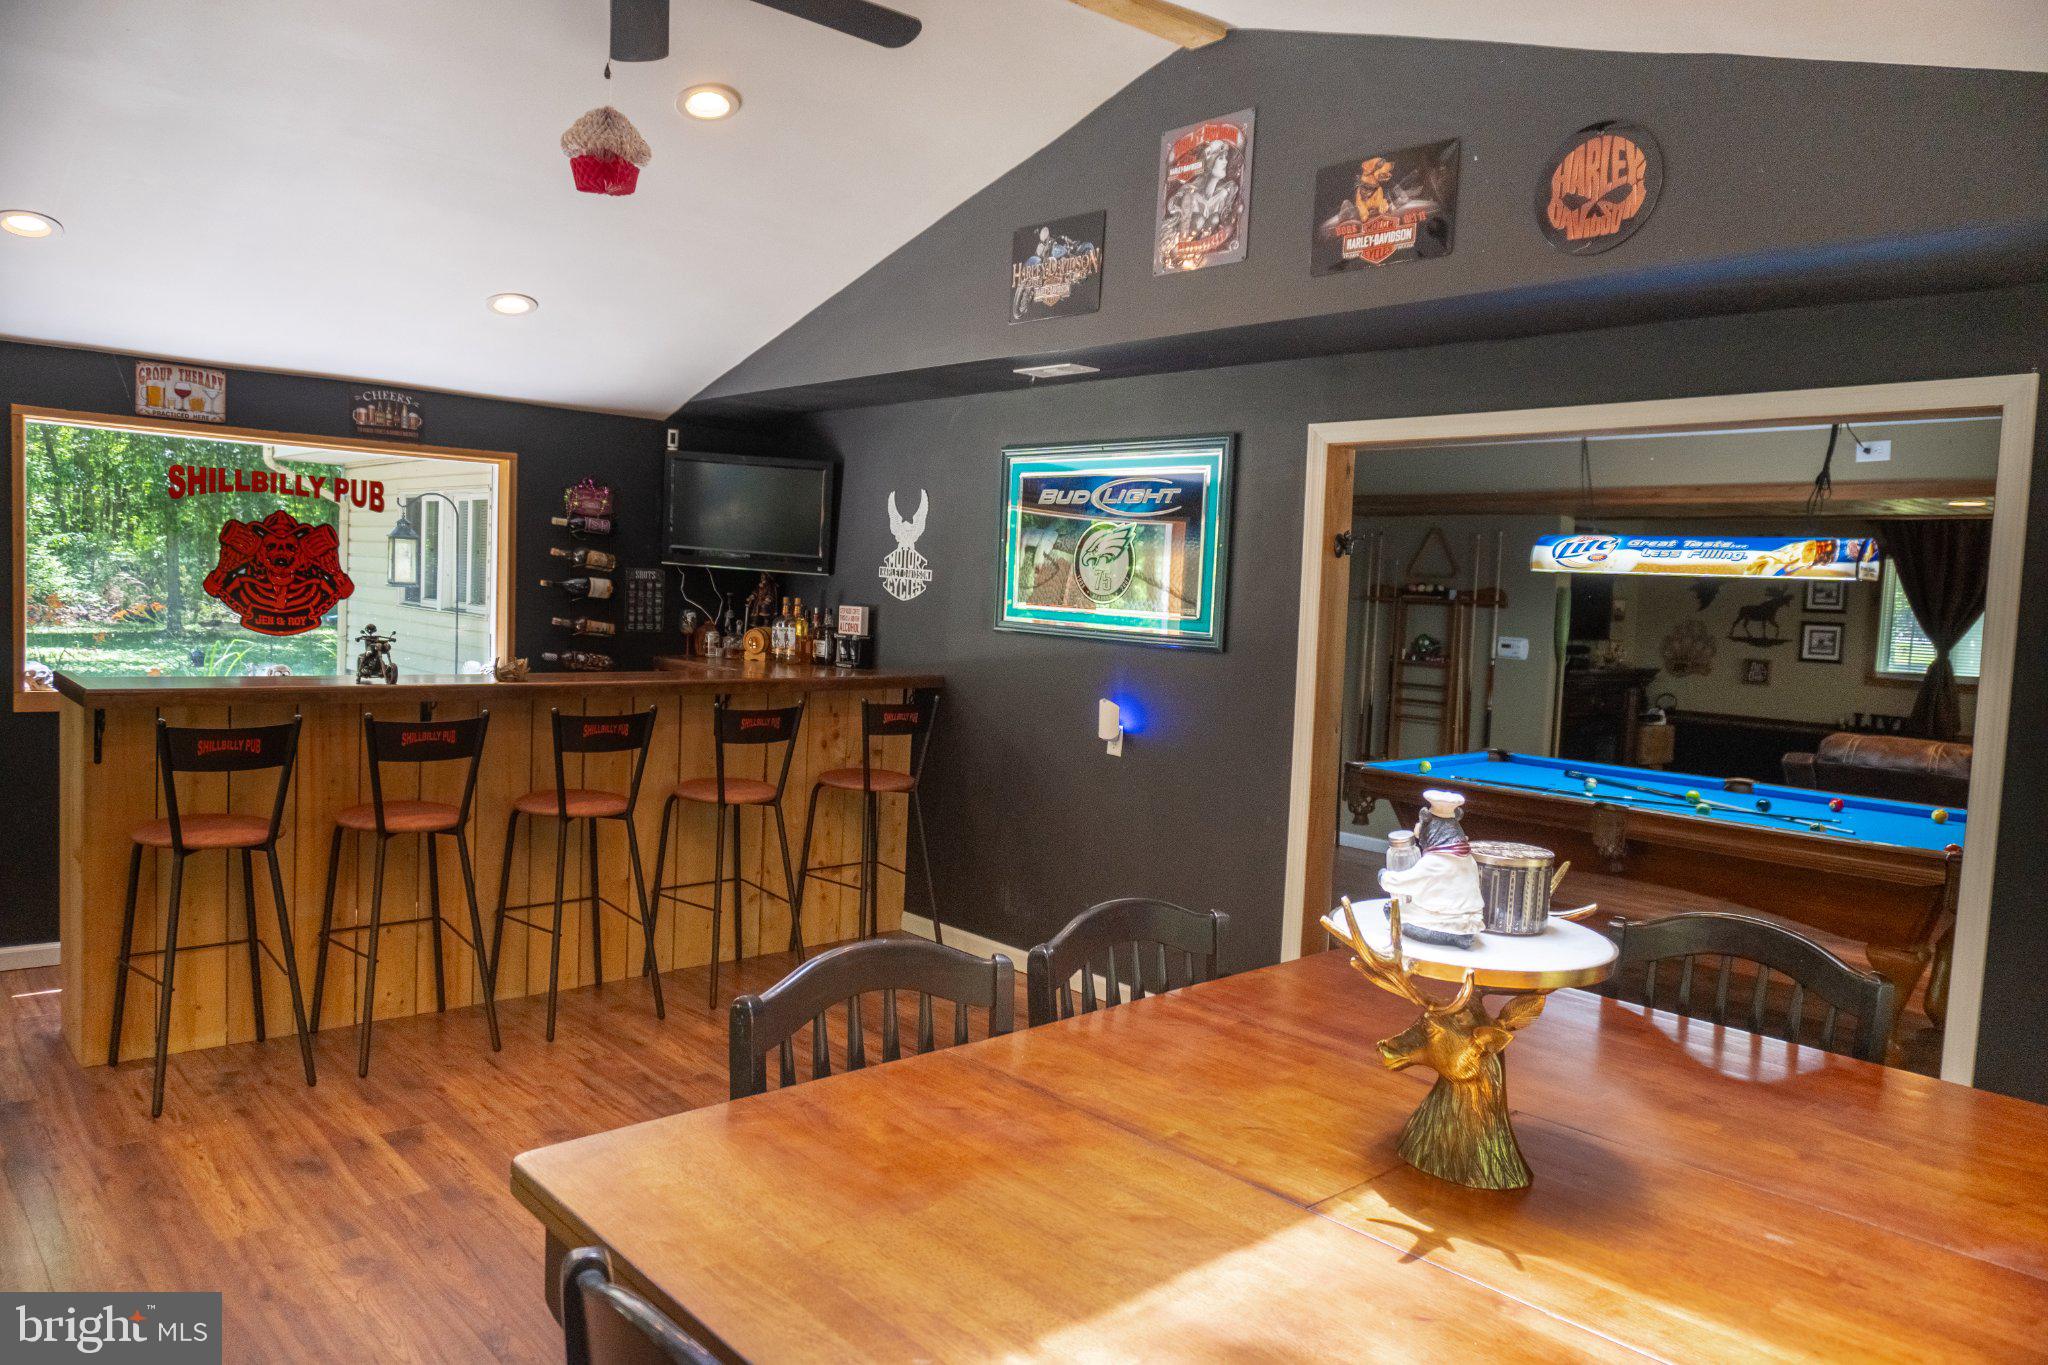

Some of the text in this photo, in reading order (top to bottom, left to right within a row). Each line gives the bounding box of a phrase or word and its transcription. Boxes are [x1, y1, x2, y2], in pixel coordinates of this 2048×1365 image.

[1552, 135, 1646, 202] HARLEY
[1346, 227, 1413, 250] HARLEY-DAVIDSON
[139, 367, 224, 390] GROUP THERAPY
[363, 390, 412, 405] CHEERS
[152, 410, 190, 419] PRACTICED
[168, 464, 385, 513] SHILLBILLY PUB
[1038, 488, 1182, 504] BUD LIGHT
[1628, 539, 1679, 548] Great
[889, 550, 922, 569] MOTOR
[1641, 548, 1682, 558] Less
[635, 570, 656, 579] SHOTS
[1094, 570, 1112, 591] 75
[839, 622, 859, 633] ALCOHOL
[442, 729, 456, 743] PUB
[197, 738, 261, 756] SHILLBILLY PUB
